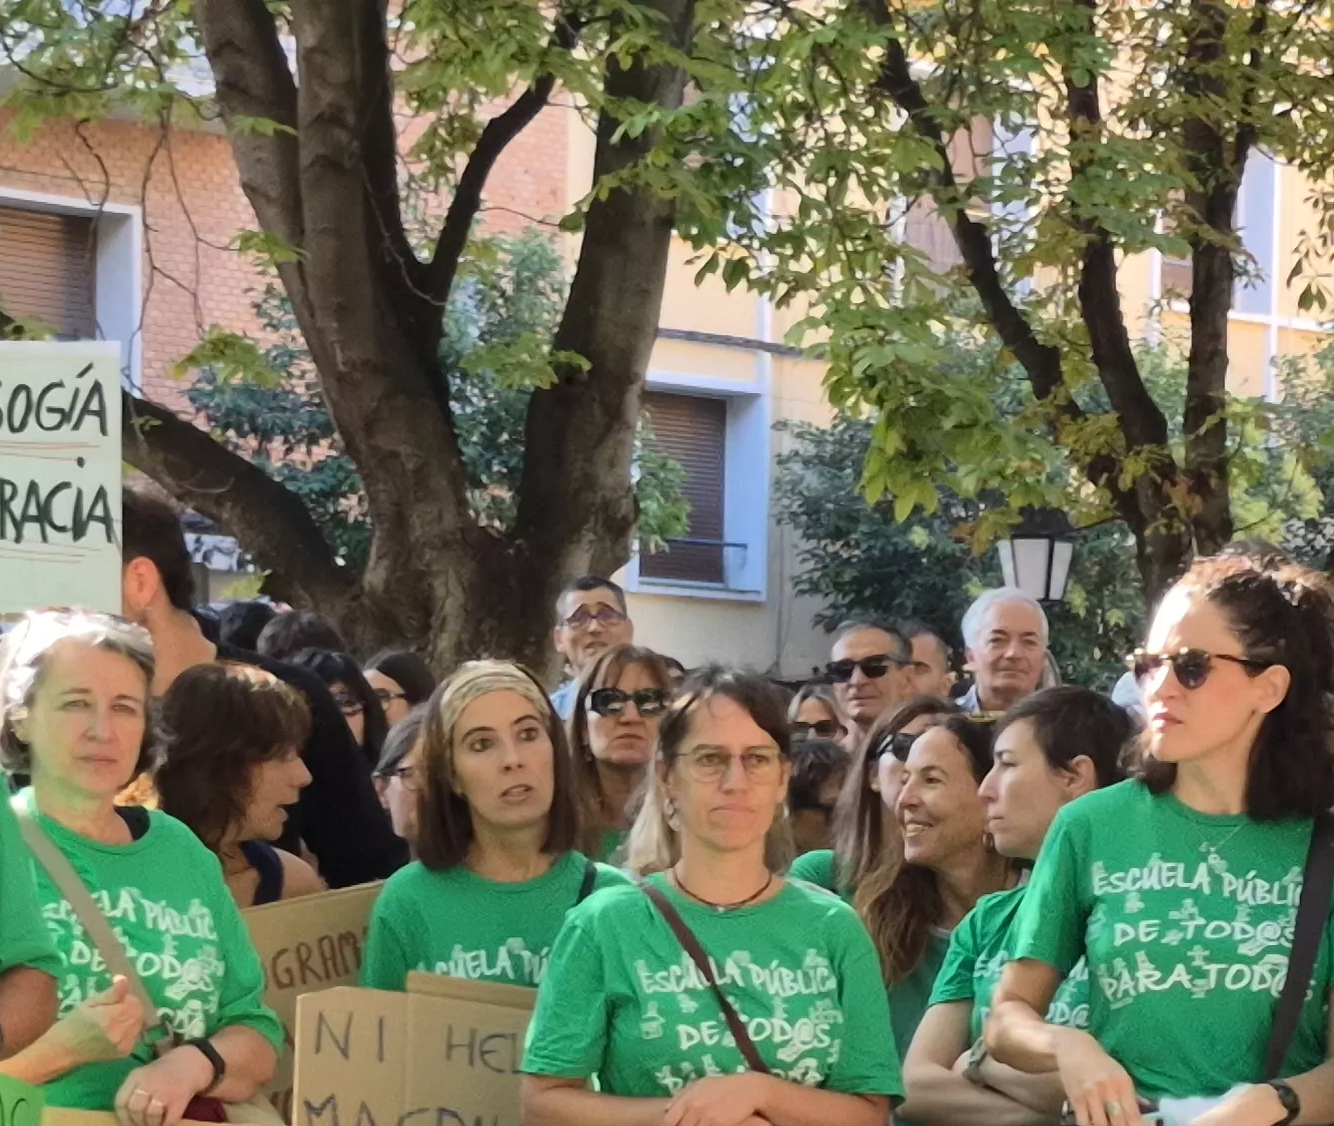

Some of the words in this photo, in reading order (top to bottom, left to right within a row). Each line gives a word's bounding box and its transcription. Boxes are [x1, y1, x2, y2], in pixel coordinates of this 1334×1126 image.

[1092, 862, 1211, 897] ESCUELA
[1113, 920, 1161, 946] DE
[271, 930, 364, 990] GRAM
[1098, 963, 1192, 1003] PARA
[316, 1011, 384, 1062] NI
[446, 1024, 523, 1075] HEL
[677, 1022, 719, 1050] DE
[748, 1018, 831, 1048] OD@S
